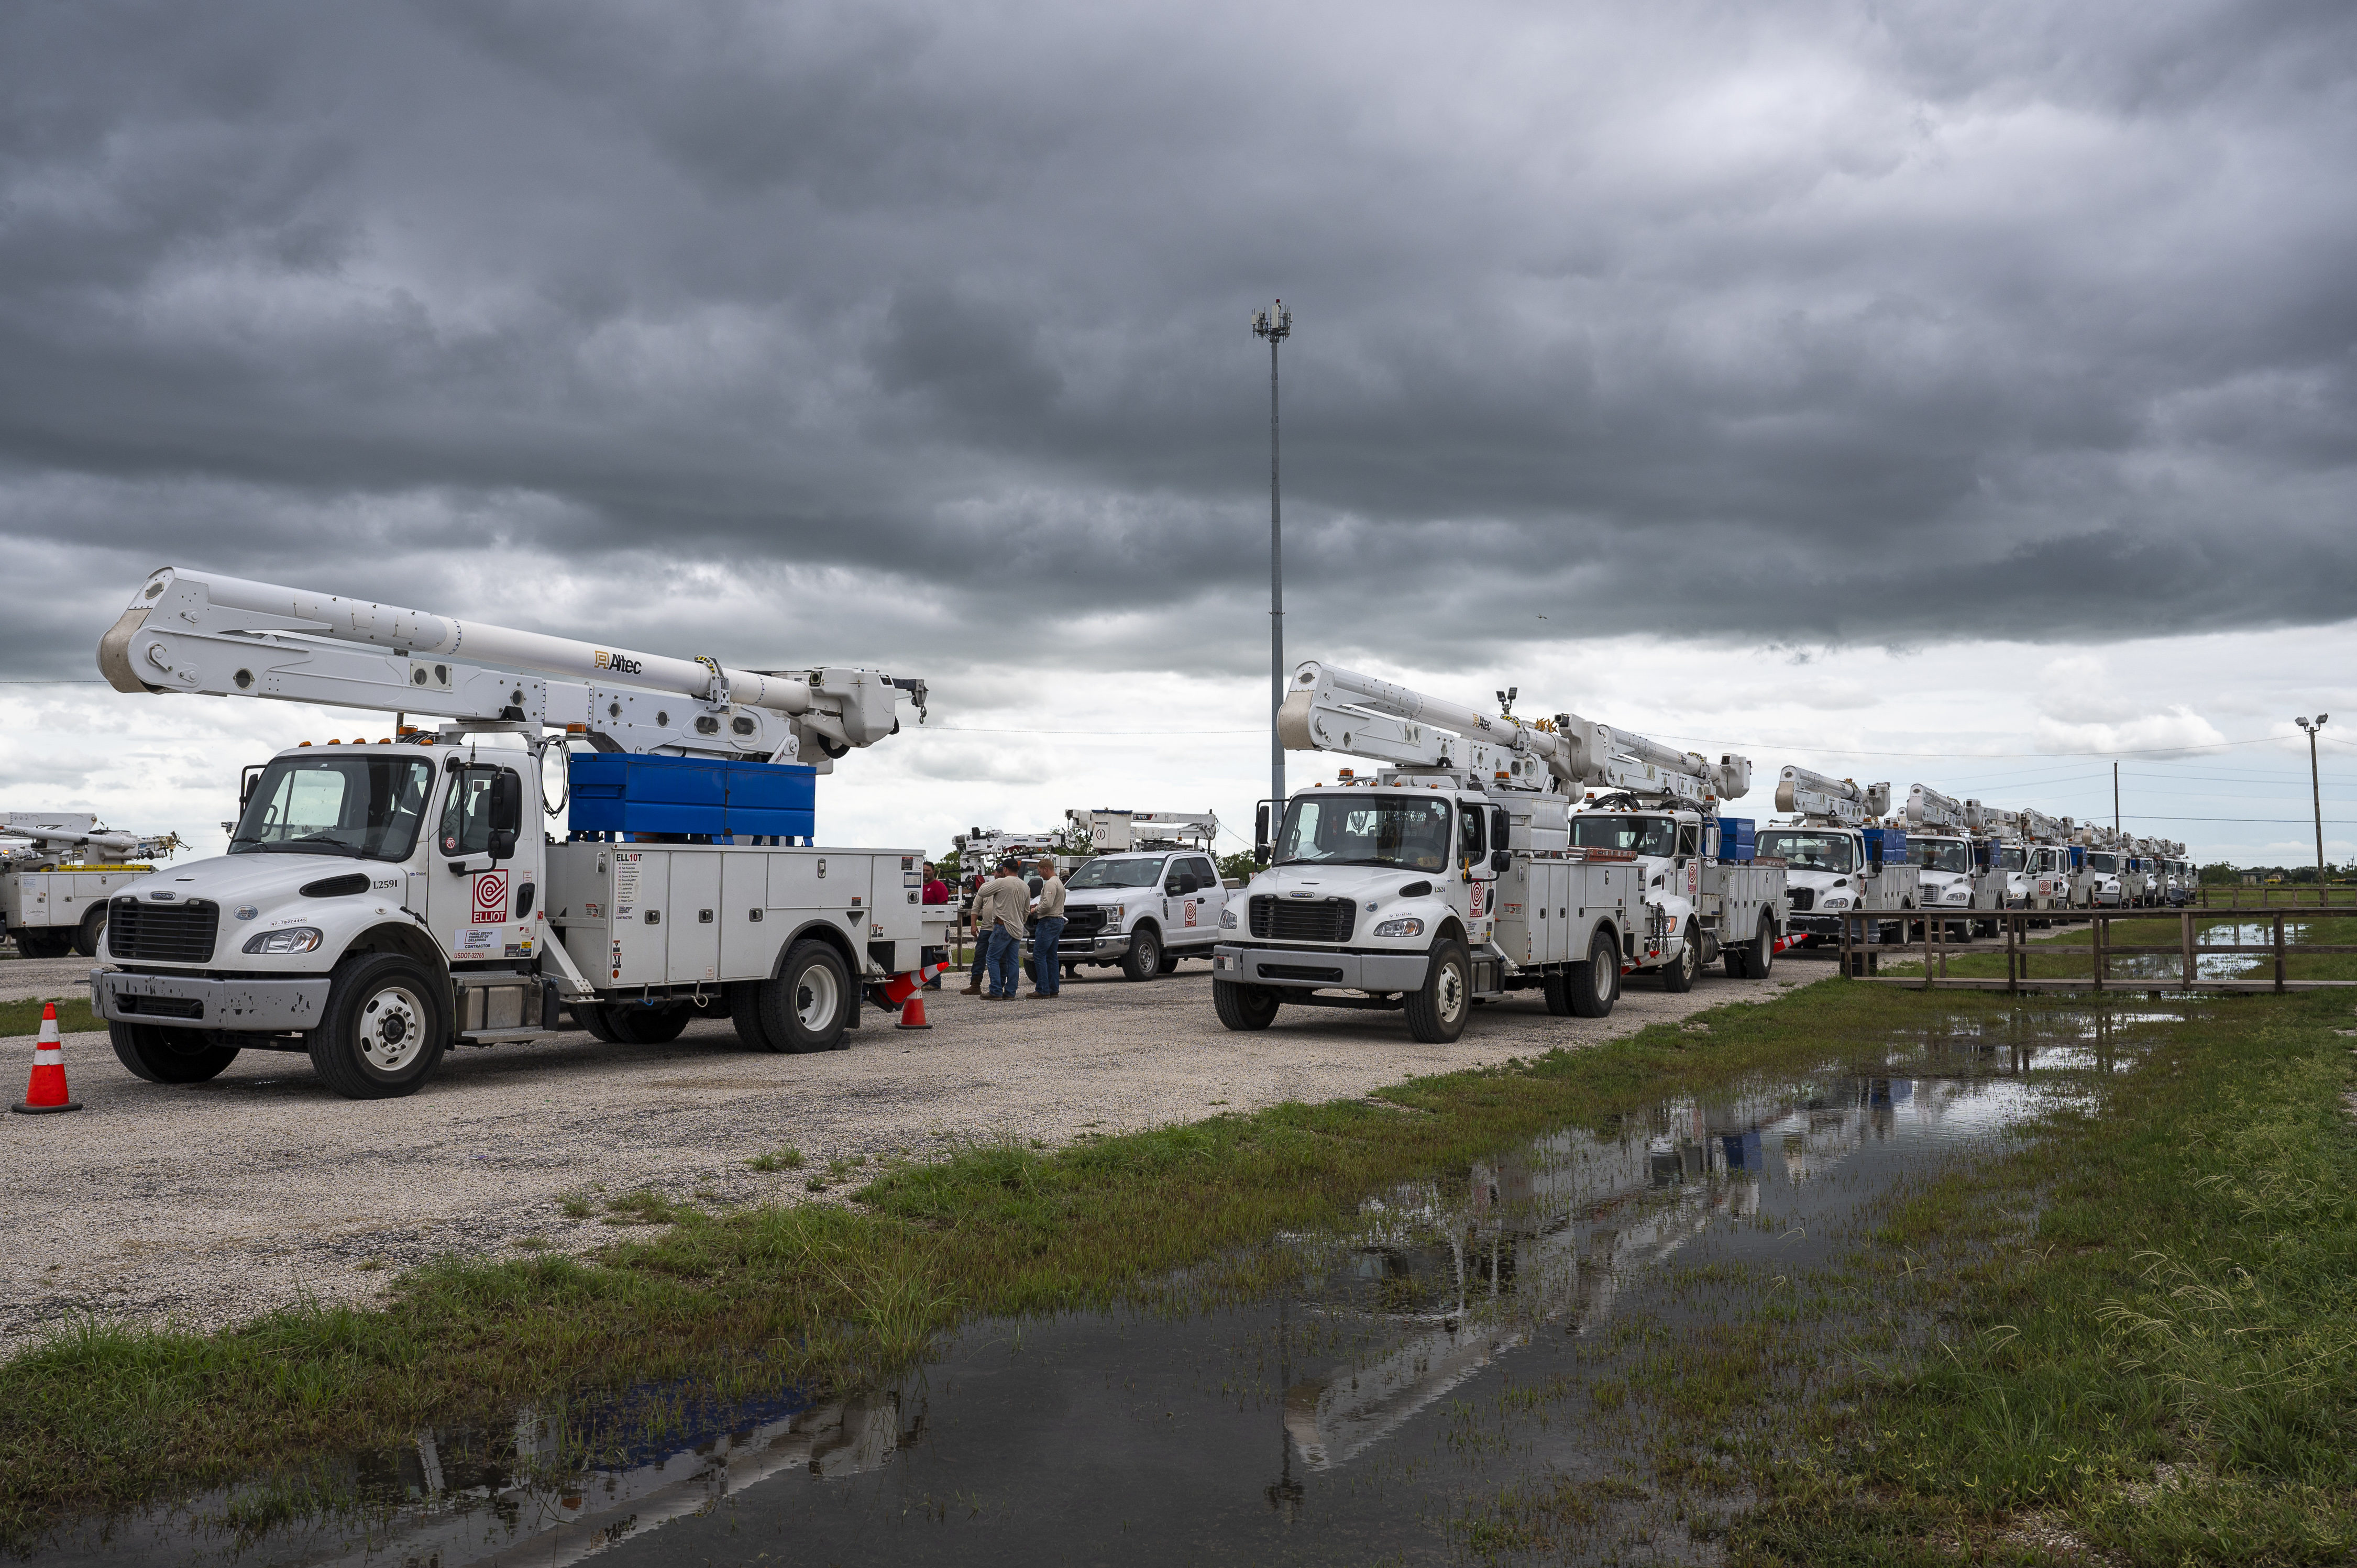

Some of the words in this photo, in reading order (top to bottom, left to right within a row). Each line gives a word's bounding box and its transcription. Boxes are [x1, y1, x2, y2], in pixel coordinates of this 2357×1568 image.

[608, 653, 642, 675] Altec
[1478, 715, 1492, 731] Altec
[10, 827, 28, 835] Altec
[616, 853, 642, 862] ELL10T
[473, 912, 505, 922] ELLIOT
